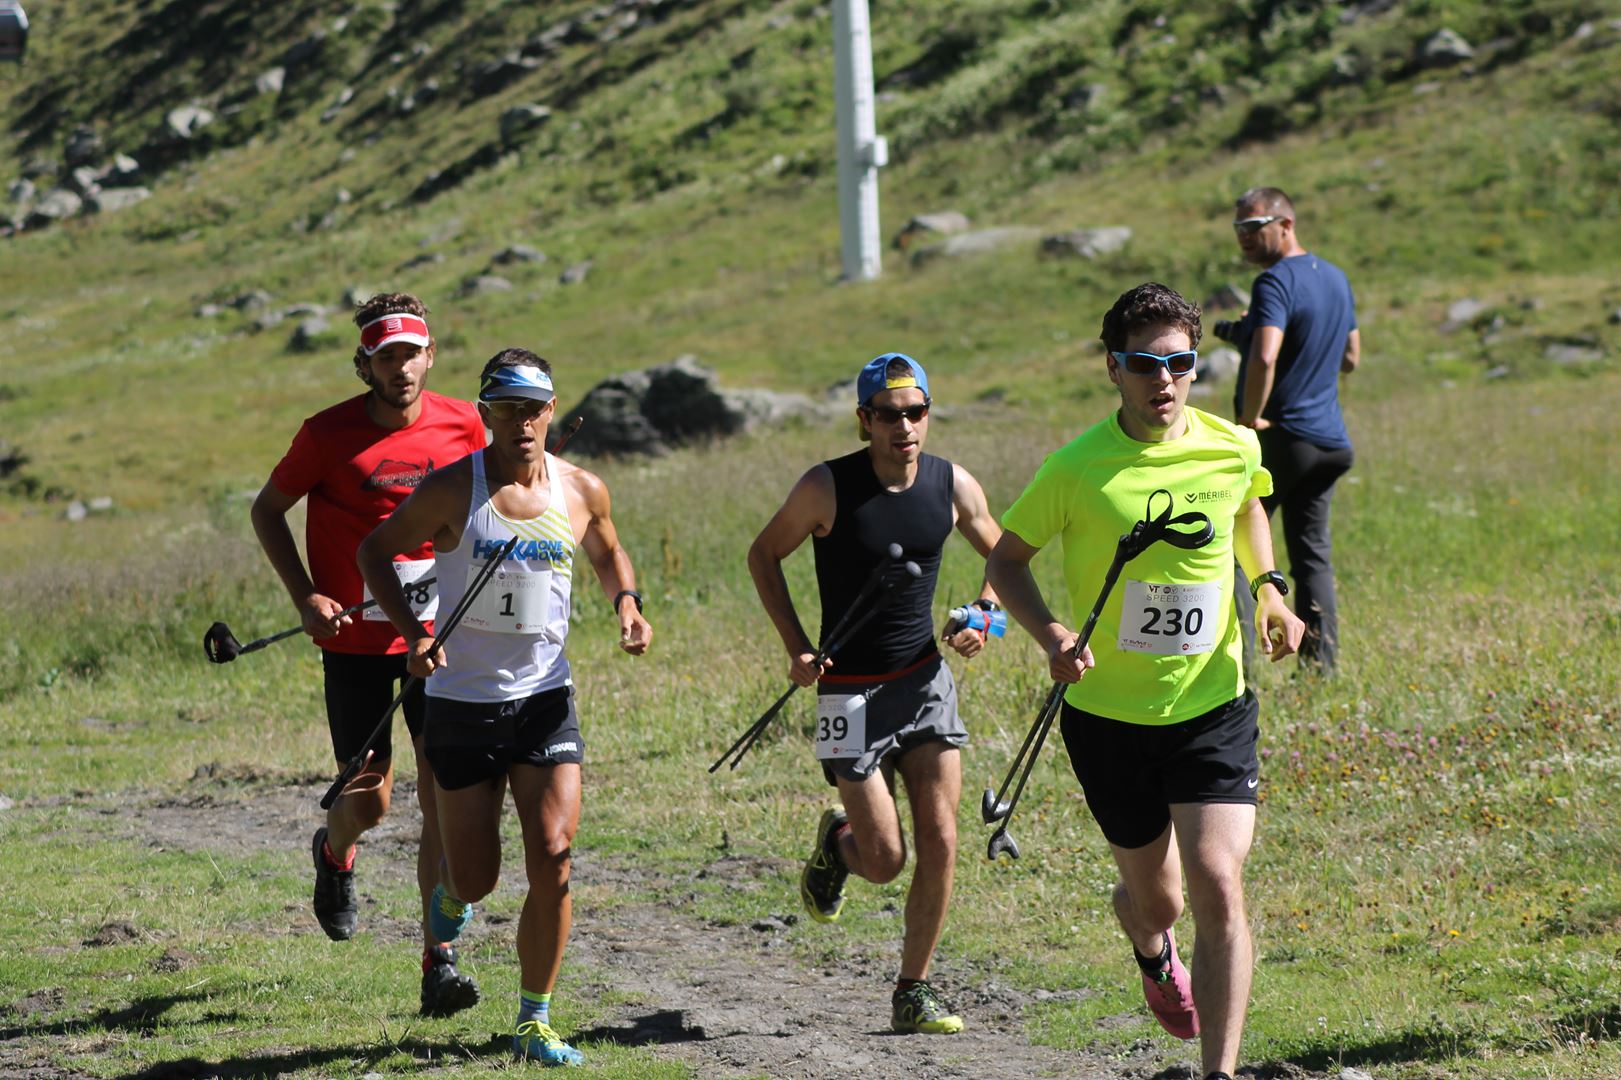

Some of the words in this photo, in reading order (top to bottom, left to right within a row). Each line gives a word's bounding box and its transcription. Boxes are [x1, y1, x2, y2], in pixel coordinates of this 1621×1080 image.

[1198, 489, 1232, 500] MÉRIBEL
[539, 540, 563, 550] ONE
[1149, 585, 1160, 593] VT
[499, 592, 515, 616] 1
[1146, 594, 1180, 603] SPEED
[1183, 594, 1205, 603] 3200
[1140, 607, 1204, 636] 230
[816, 715, 849, 742] 39
